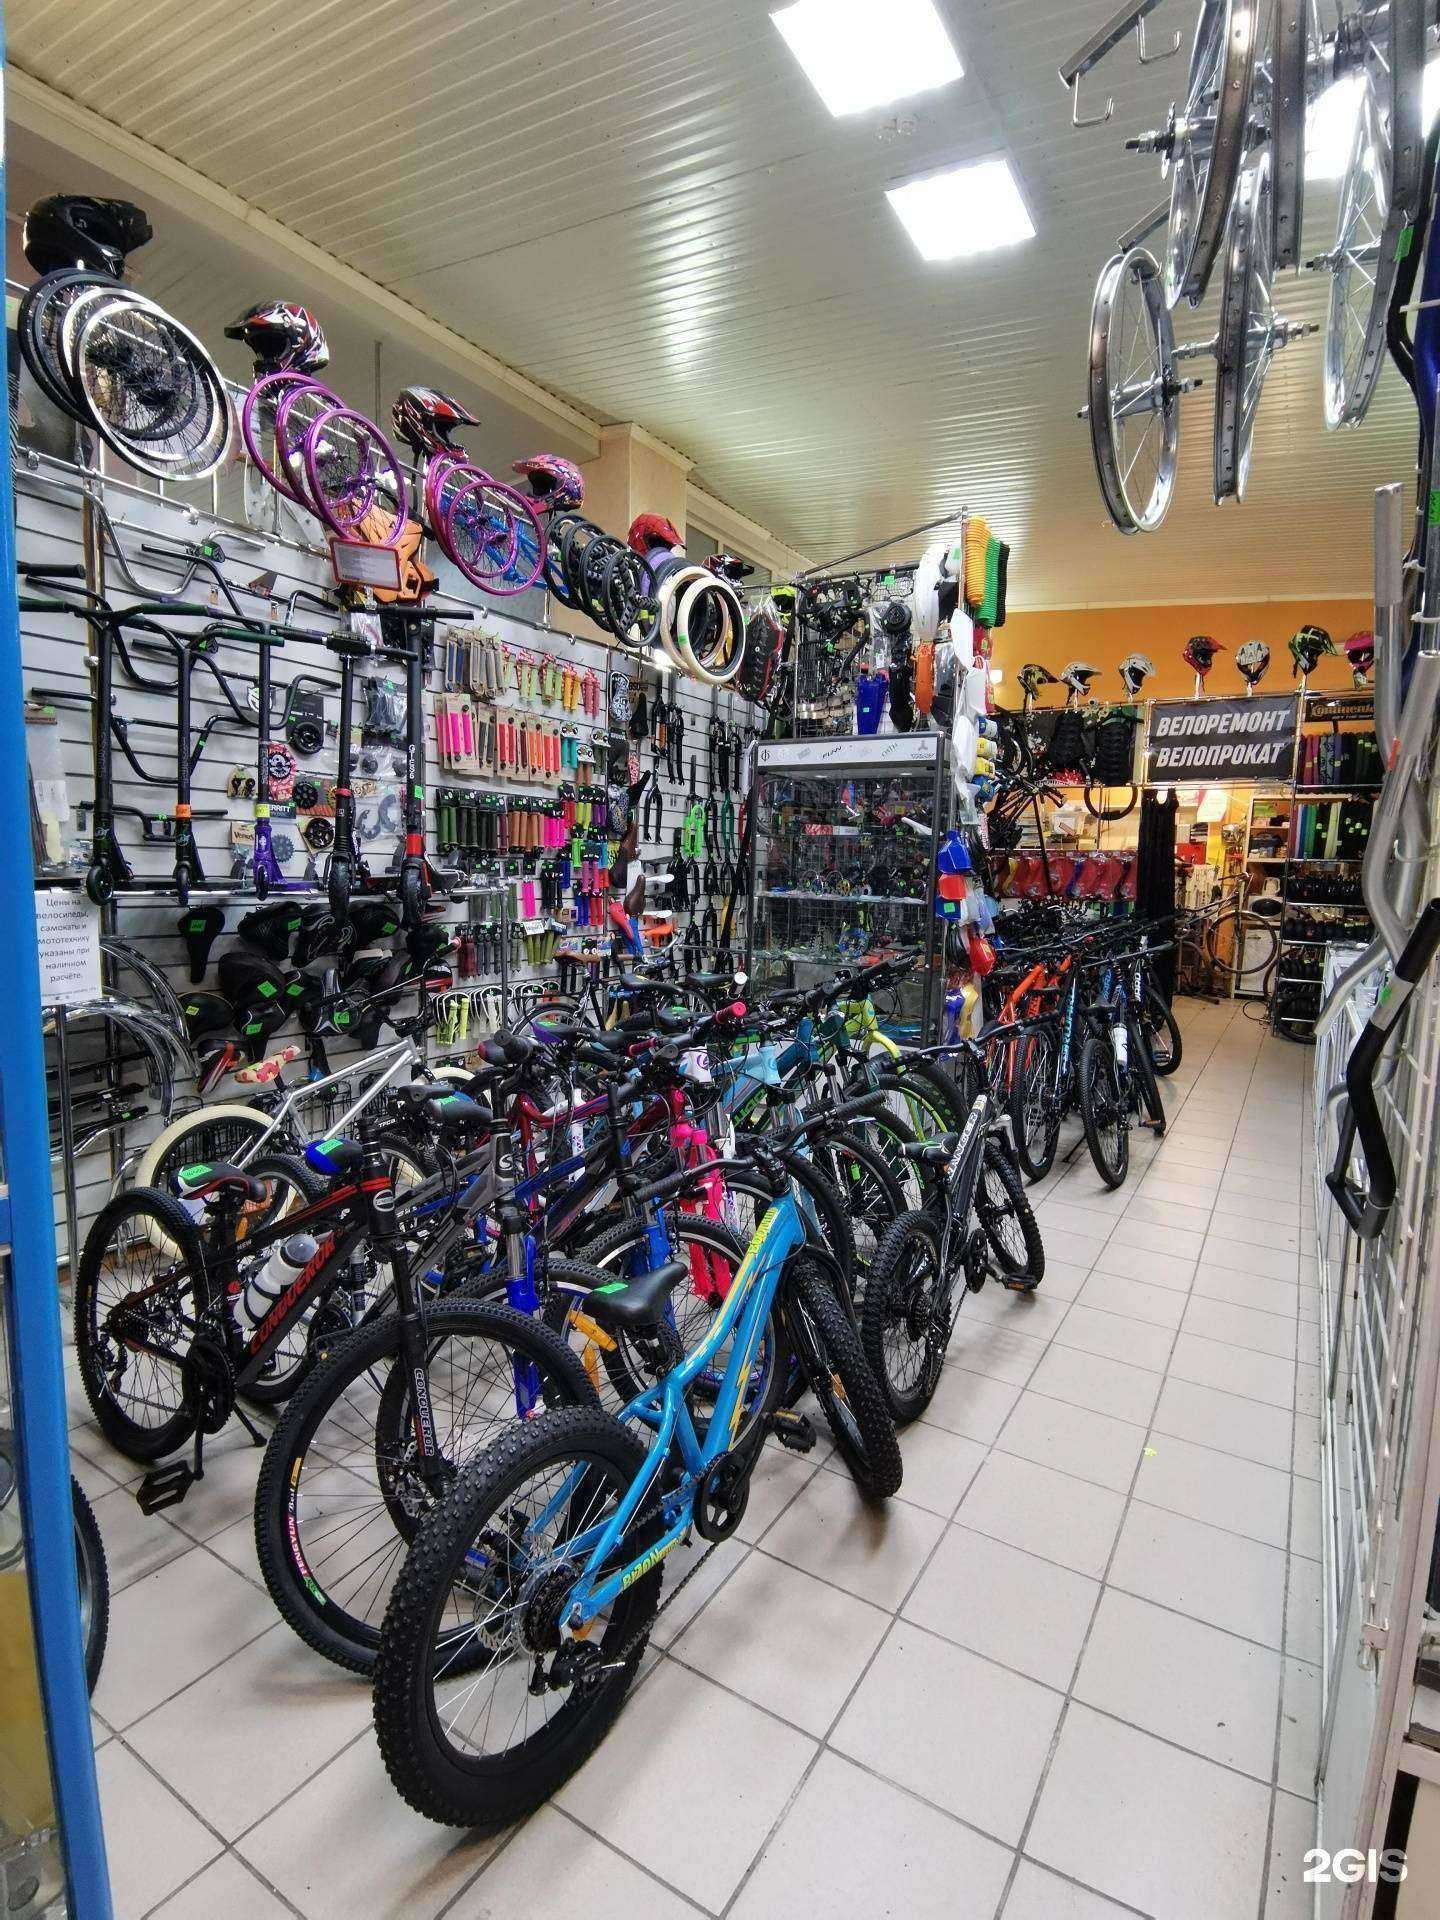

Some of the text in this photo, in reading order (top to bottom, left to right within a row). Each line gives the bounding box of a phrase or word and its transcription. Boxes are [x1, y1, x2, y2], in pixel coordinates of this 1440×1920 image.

[1156, 710, 1290, 736] ВЕЛОРЕМОНТ
[1156, 743, 1284, 768] ВЕЛОПРОКАТ
[47, 899, 70, 907] Цены
[41, 924, 80, 932] самокаты
[38, 936, 89, 945] мототехнику
[39, 947, 90, 958] указаны при
[46, 960, 87, 969] наличном
[414, 1367, 435, 1457] CONQUEROR
